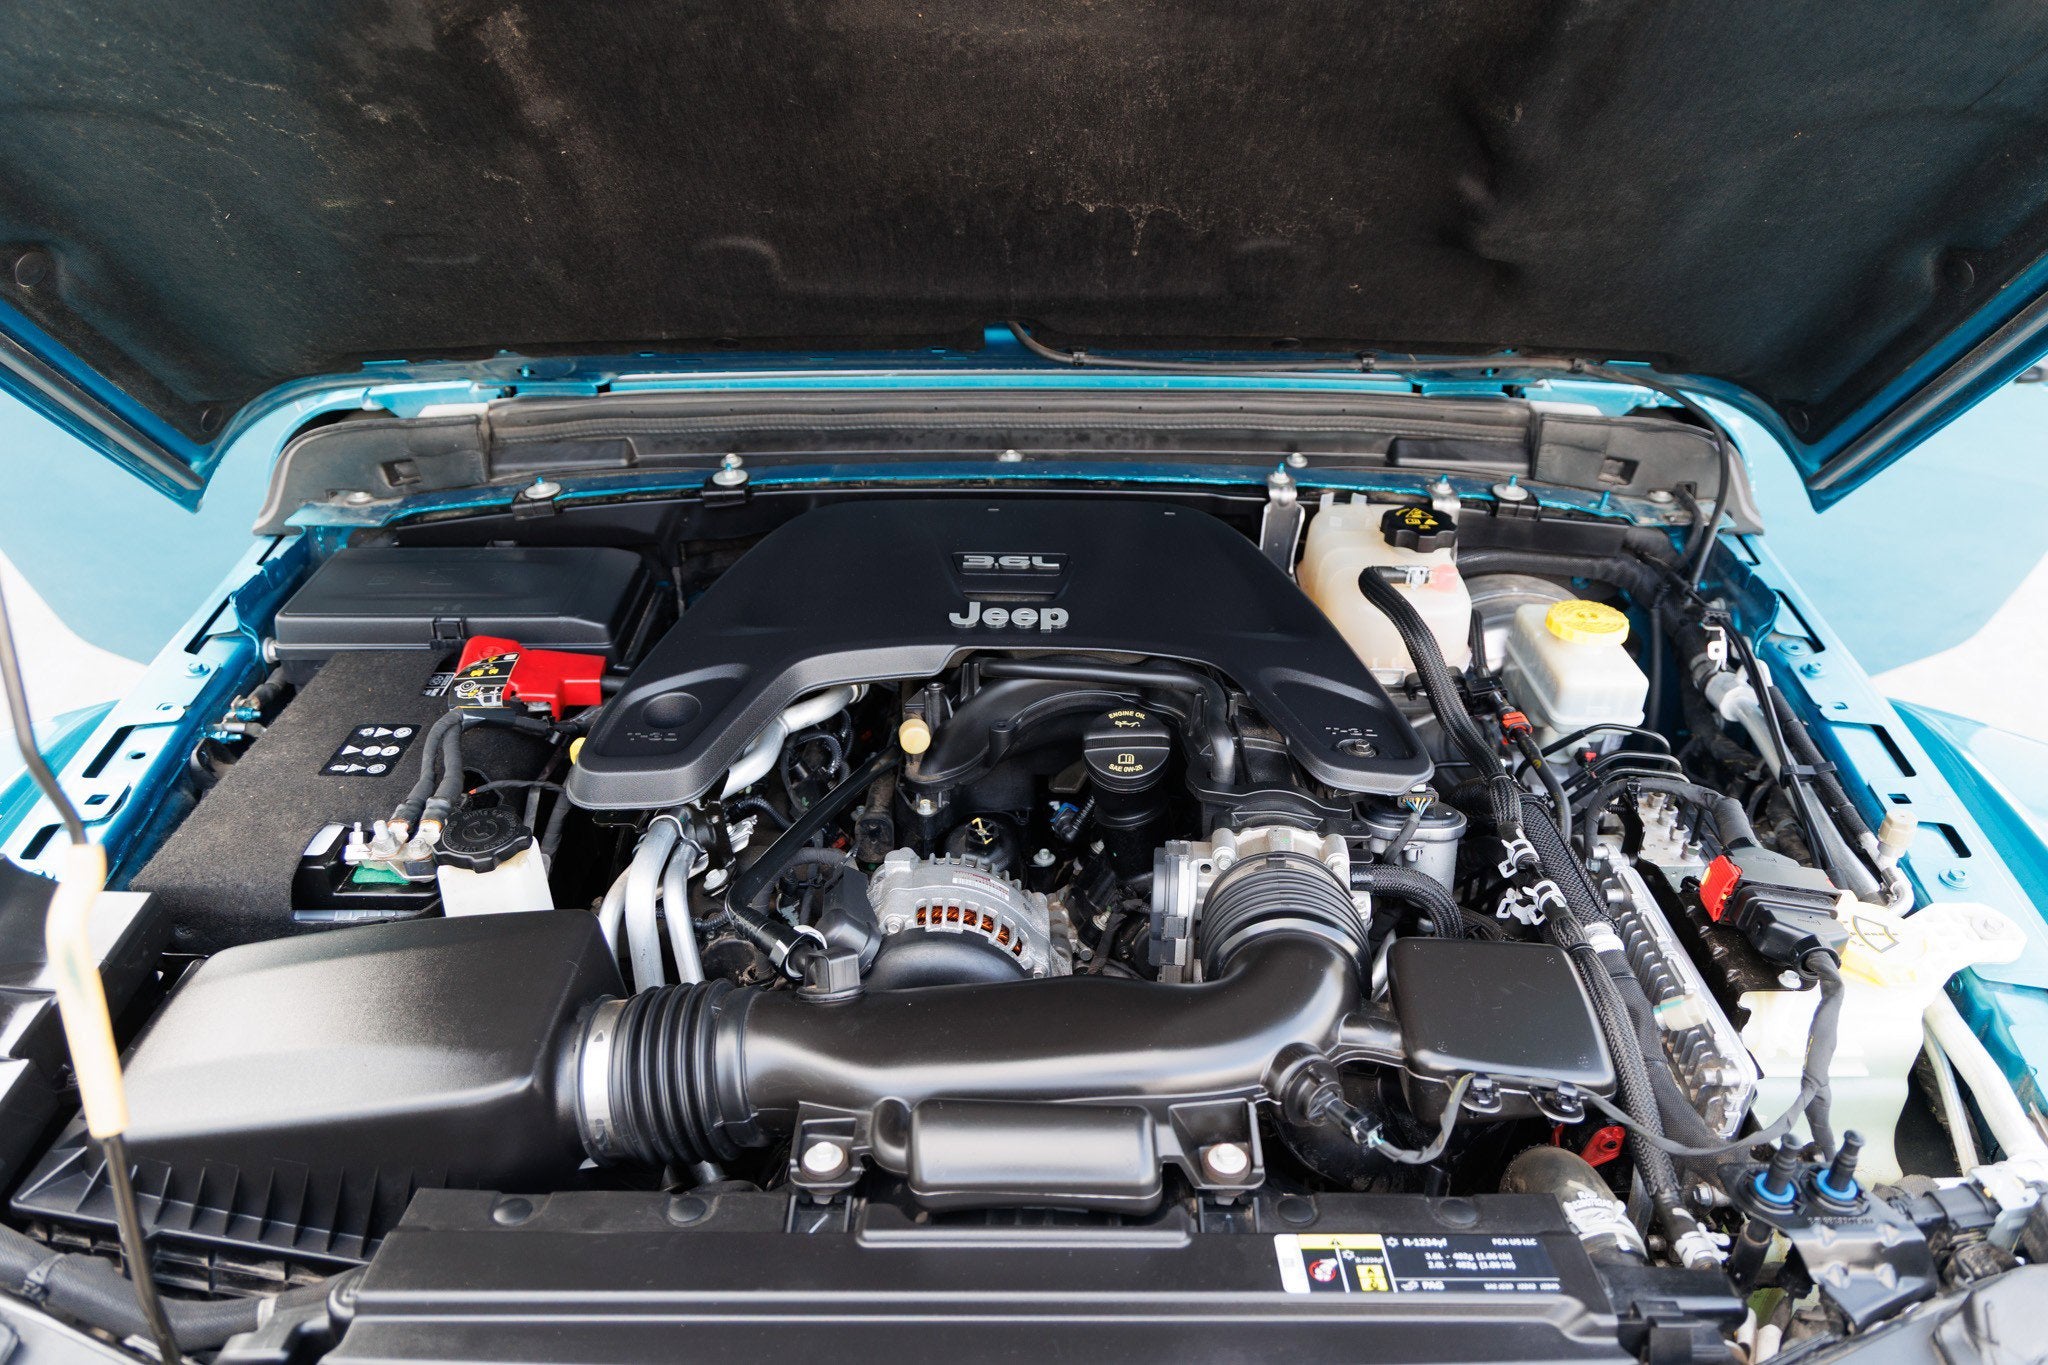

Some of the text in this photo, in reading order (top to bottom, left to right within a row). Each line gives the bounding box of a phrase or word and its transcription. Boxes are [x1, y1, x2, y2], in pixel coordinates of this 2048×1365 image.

[962, 555, 1060, 570] 3.6L
[949, 601, 1069, 634] Jeep
[1108, 711, 1134, 719] ENGINE
[1108, 764, 1122, 772] SAE
[1402, 1238, 1447, 1248] R-1234yf
[1491, 1238, 1538, 1246] FCA US LLC
